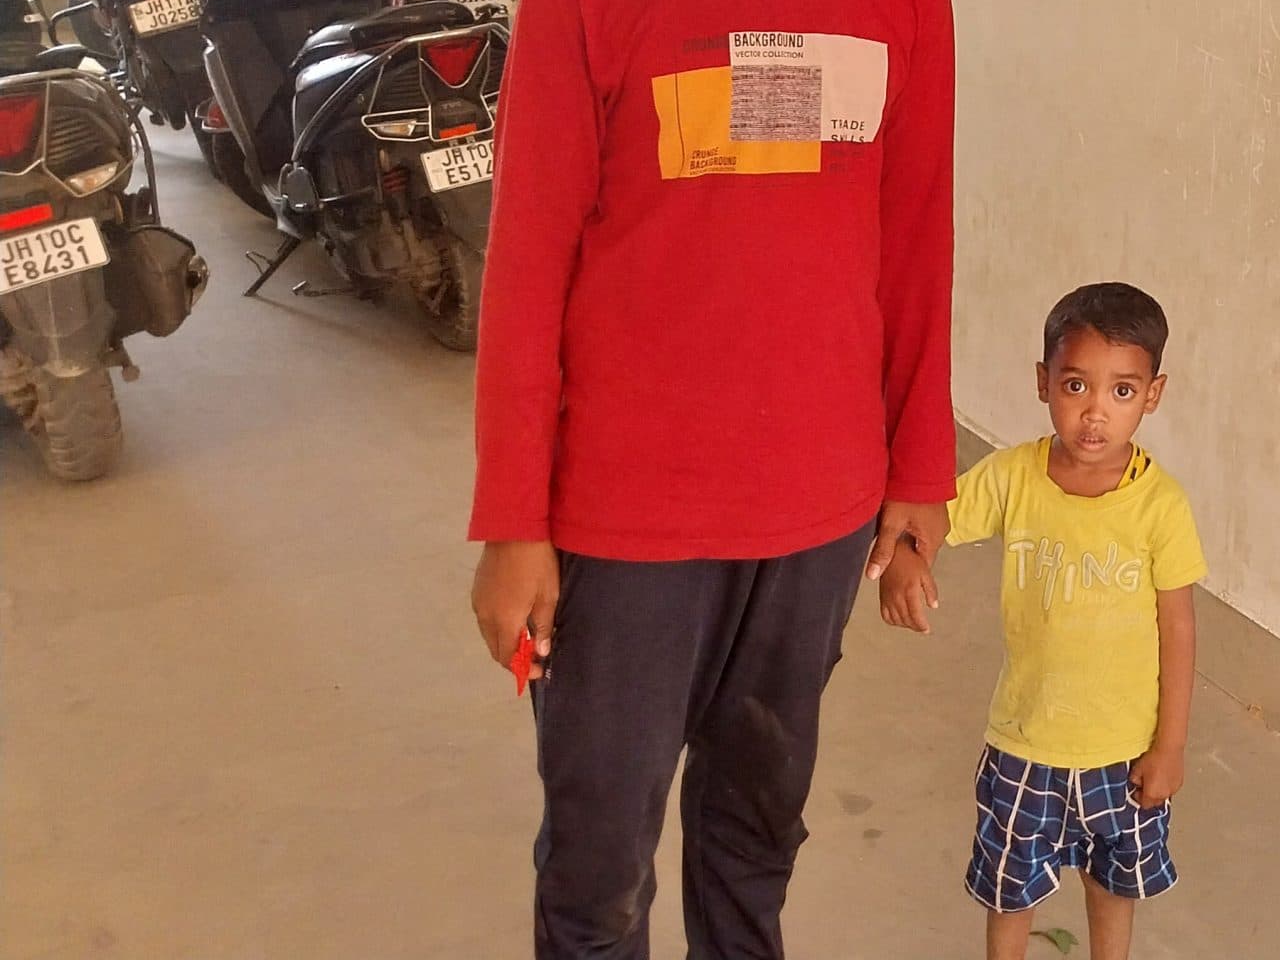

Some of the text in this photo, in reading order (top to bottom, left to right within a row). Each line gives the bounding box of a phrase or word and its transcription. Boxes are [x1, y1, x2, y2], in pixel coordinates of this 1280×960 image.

[734, 33, 804, 48] BACKGROUND
[763, 51, 804, 59] COLLECTION
[2, 224, 85, 264] JH10C
[4, 246, 90, 286] E8431
[1009, 537, 1142, 611] THING
